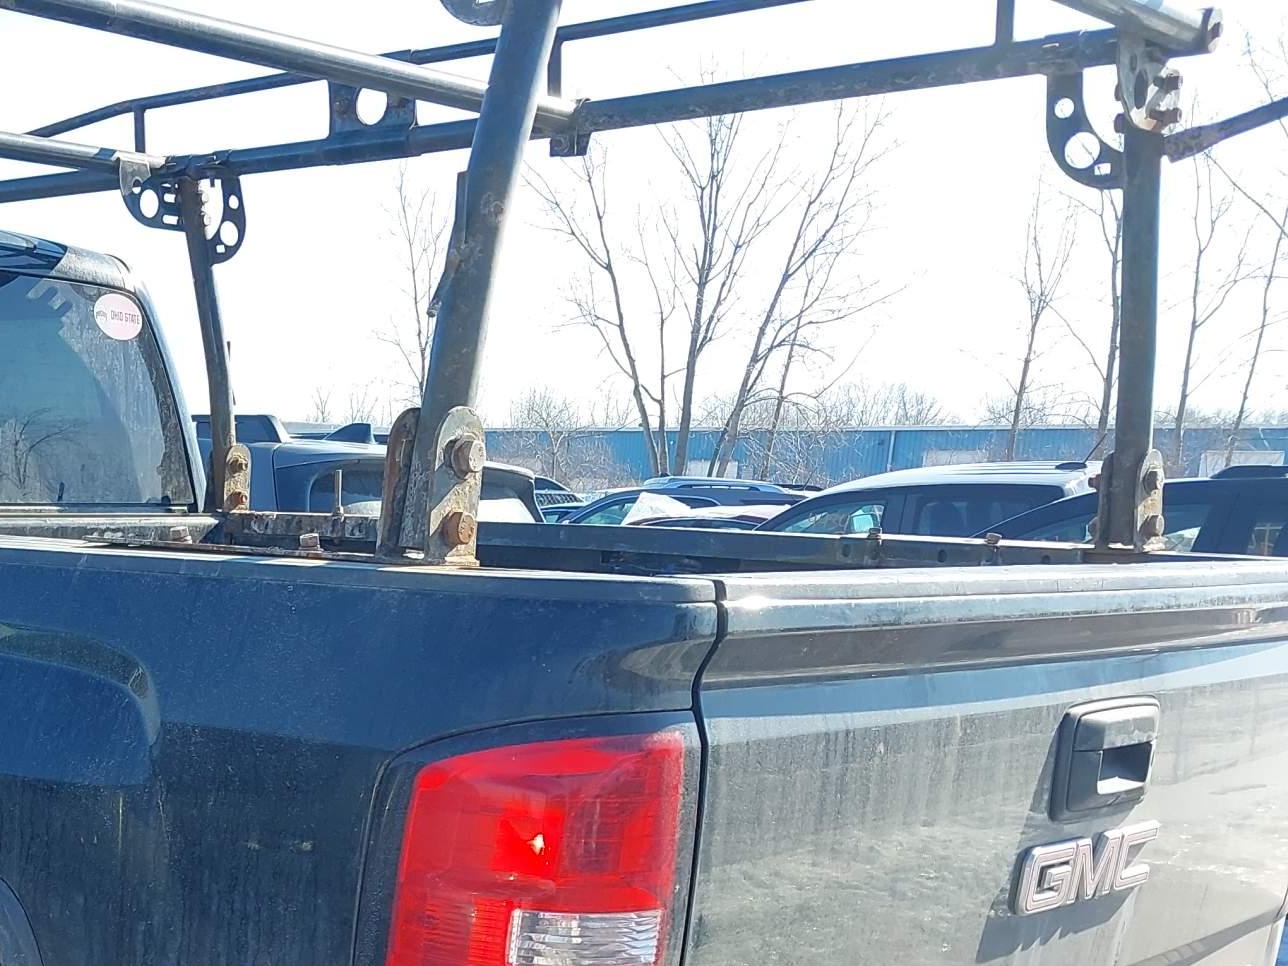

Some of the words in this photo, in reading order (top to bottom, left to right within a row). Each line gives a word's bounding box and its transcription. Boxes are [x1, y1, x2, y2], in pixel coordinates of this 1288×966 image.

[110, 310, 123, 322] OHIO
[124, 312, 140, 325] STATE
[1014, 819, 1161, 917] GMC
